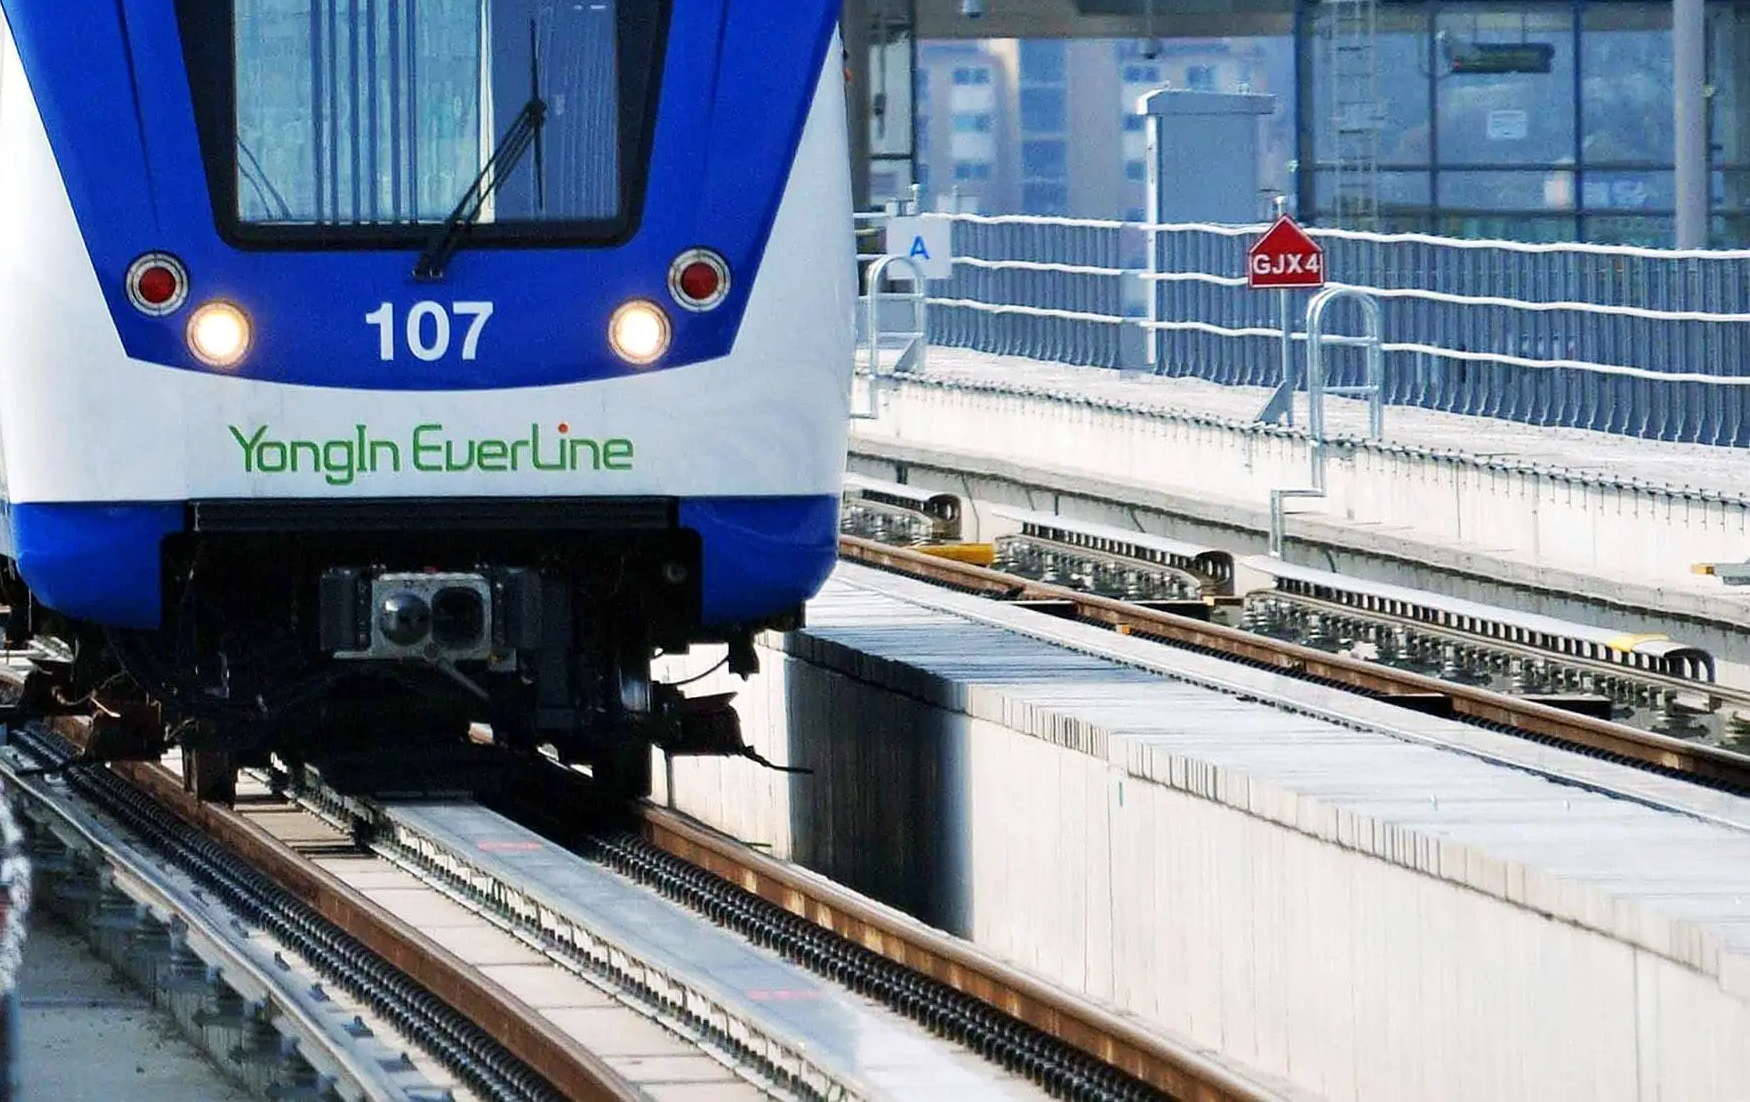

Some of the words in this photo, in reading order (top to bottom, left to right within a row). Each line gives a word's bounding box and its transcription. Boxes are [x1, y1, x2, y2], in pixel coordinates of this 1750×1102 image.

[909, 235, 931, 260] A
[1253, 253, 1320, 275] GJX4
[365, 300, 494, 362] 107
[228, 424, 400, 486] YongIn
[413, 422, 635, 472] EverLine
